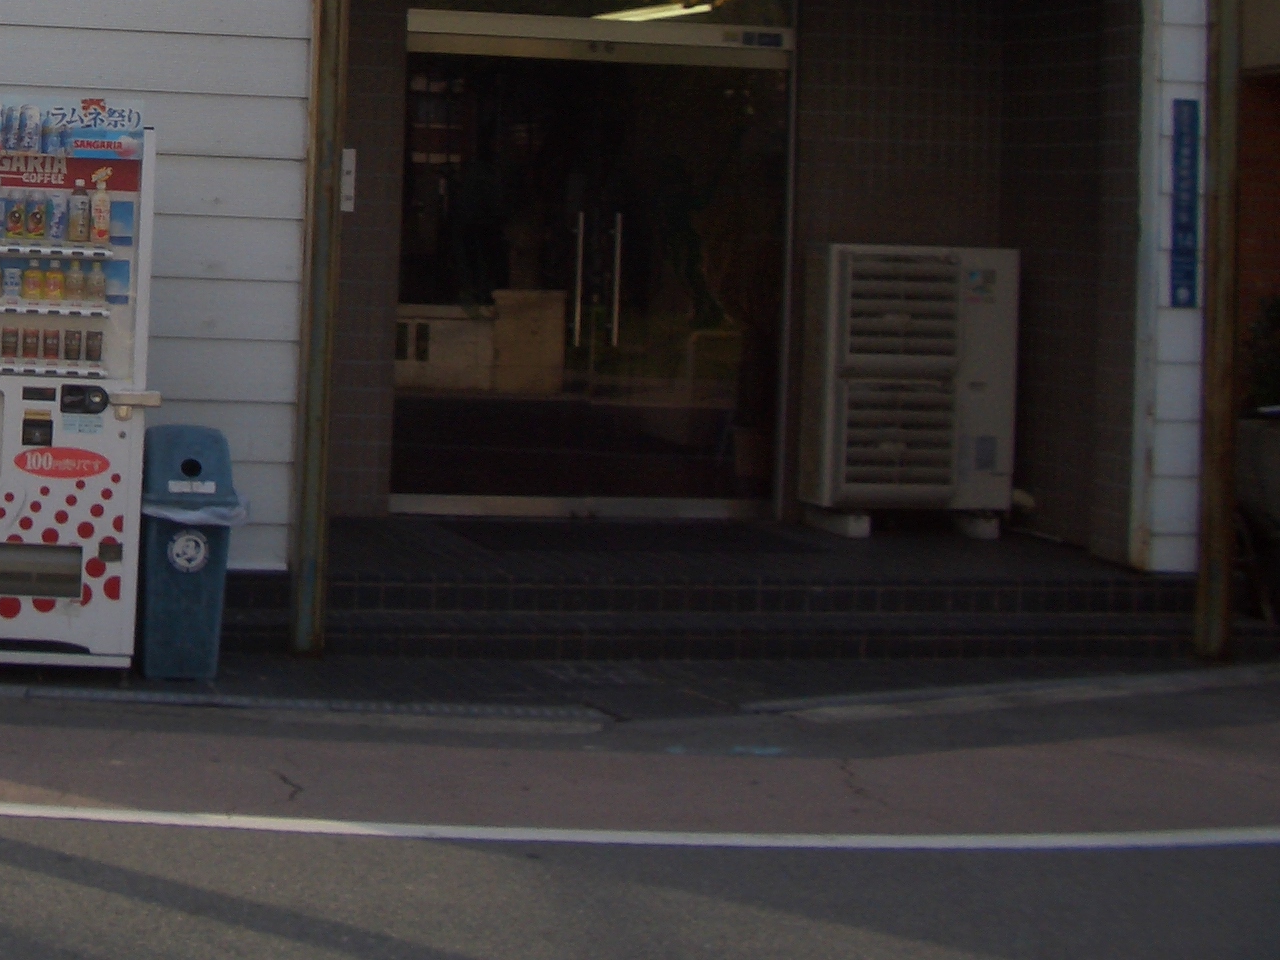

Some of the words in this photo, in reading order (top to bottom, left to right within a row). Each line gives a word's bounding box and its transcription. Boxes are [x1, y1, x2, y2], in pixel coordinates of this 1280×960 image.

[51, 107, 142, 129] ラムネ祭り
[73, 139, 123, 150] SANGARIA
[22, 173, 65, 185] COFFEE
